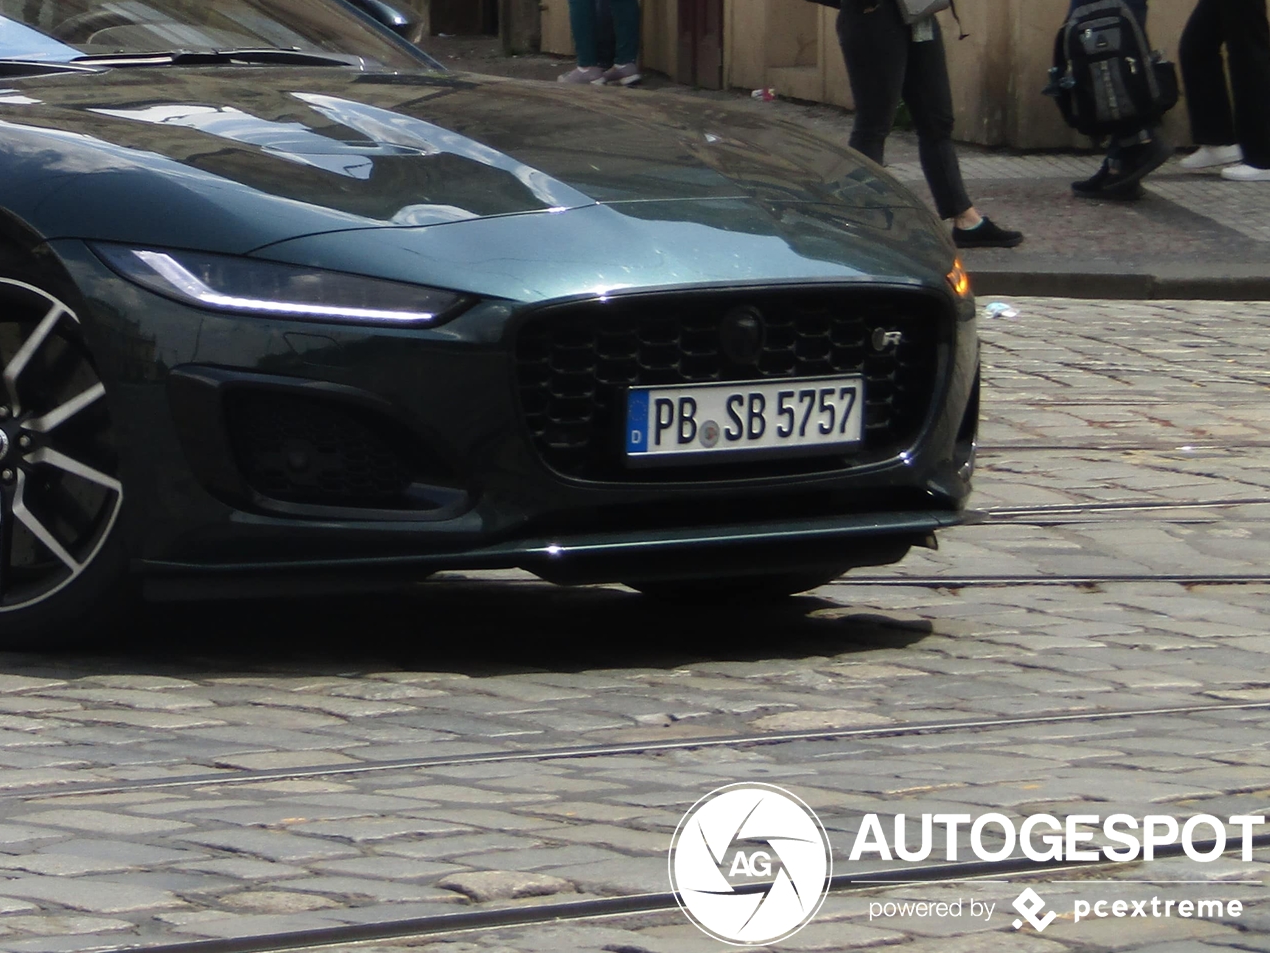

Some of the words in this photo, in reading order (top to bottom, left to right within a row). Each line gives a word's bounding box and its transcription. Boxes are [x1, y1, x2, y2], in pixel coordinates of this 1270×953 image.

[654, 396, 697, 446] PB
[724, 392, 767, 441] SB
[776, 386, 857, 438] 5757
[631, 429, 642, 444] D
